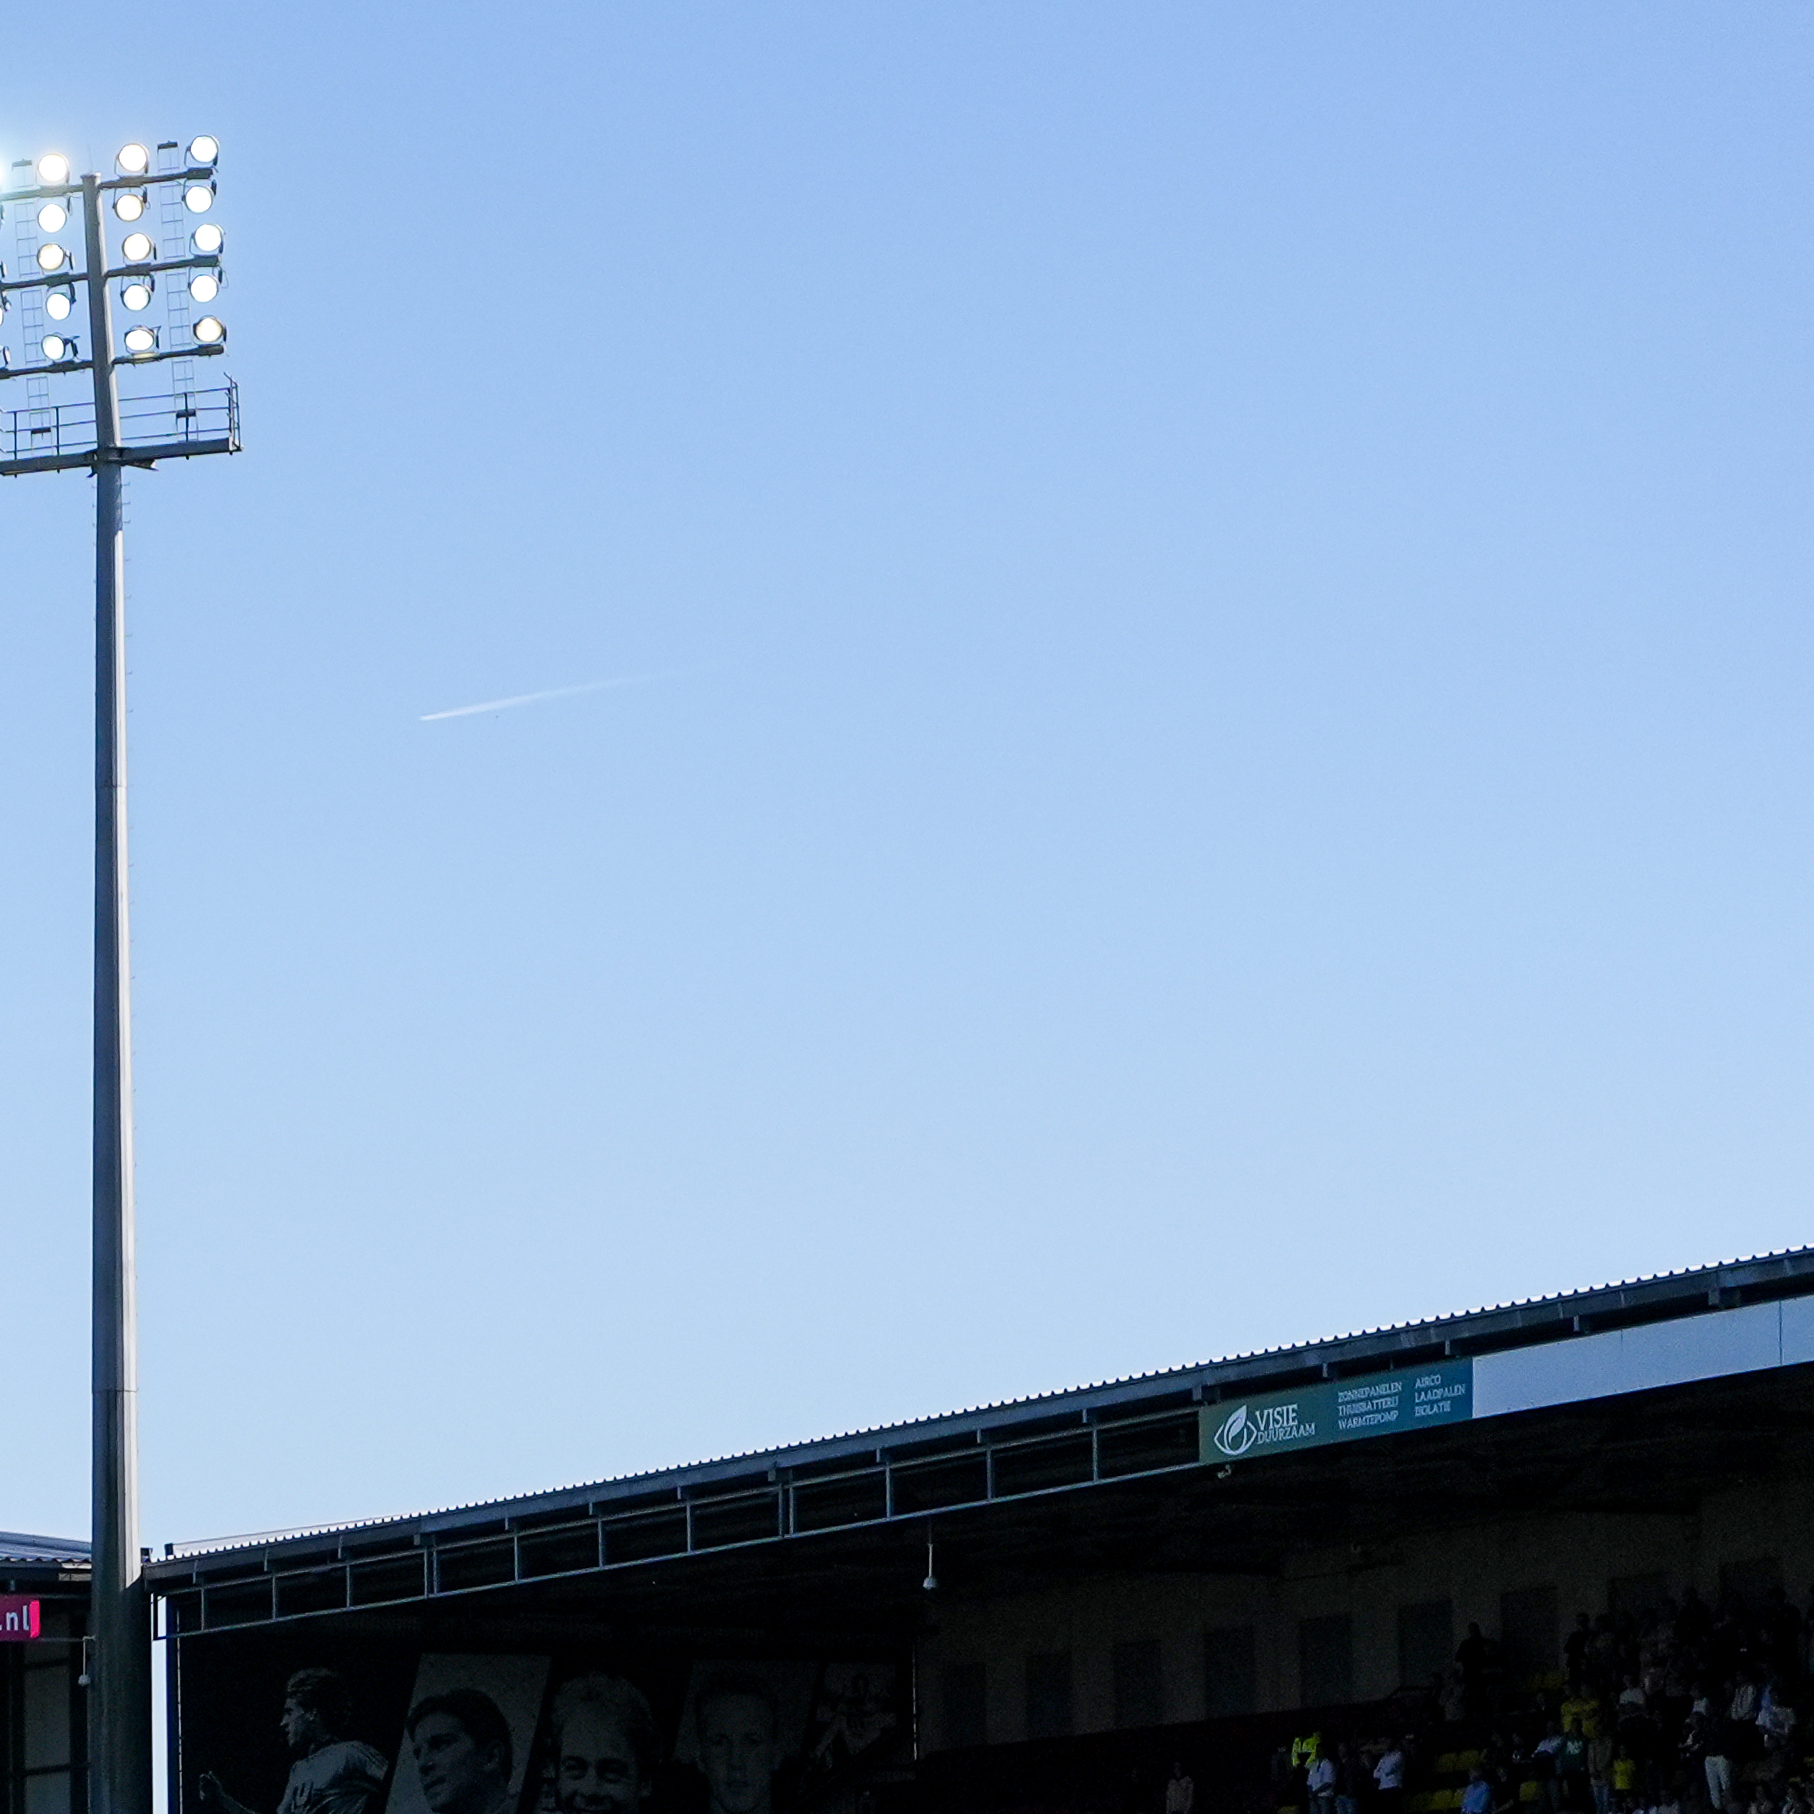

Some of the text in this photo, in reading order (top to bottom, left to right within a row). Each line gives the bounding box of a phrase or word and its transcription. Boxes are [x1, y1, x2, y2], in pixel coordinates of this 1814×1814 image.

[1414, 1373, 1442, 1389] AIRCO
[1255, 1403, 1299, 1431] VISIE
[1256, 1422, 1316, 1445] DUURZAAM
